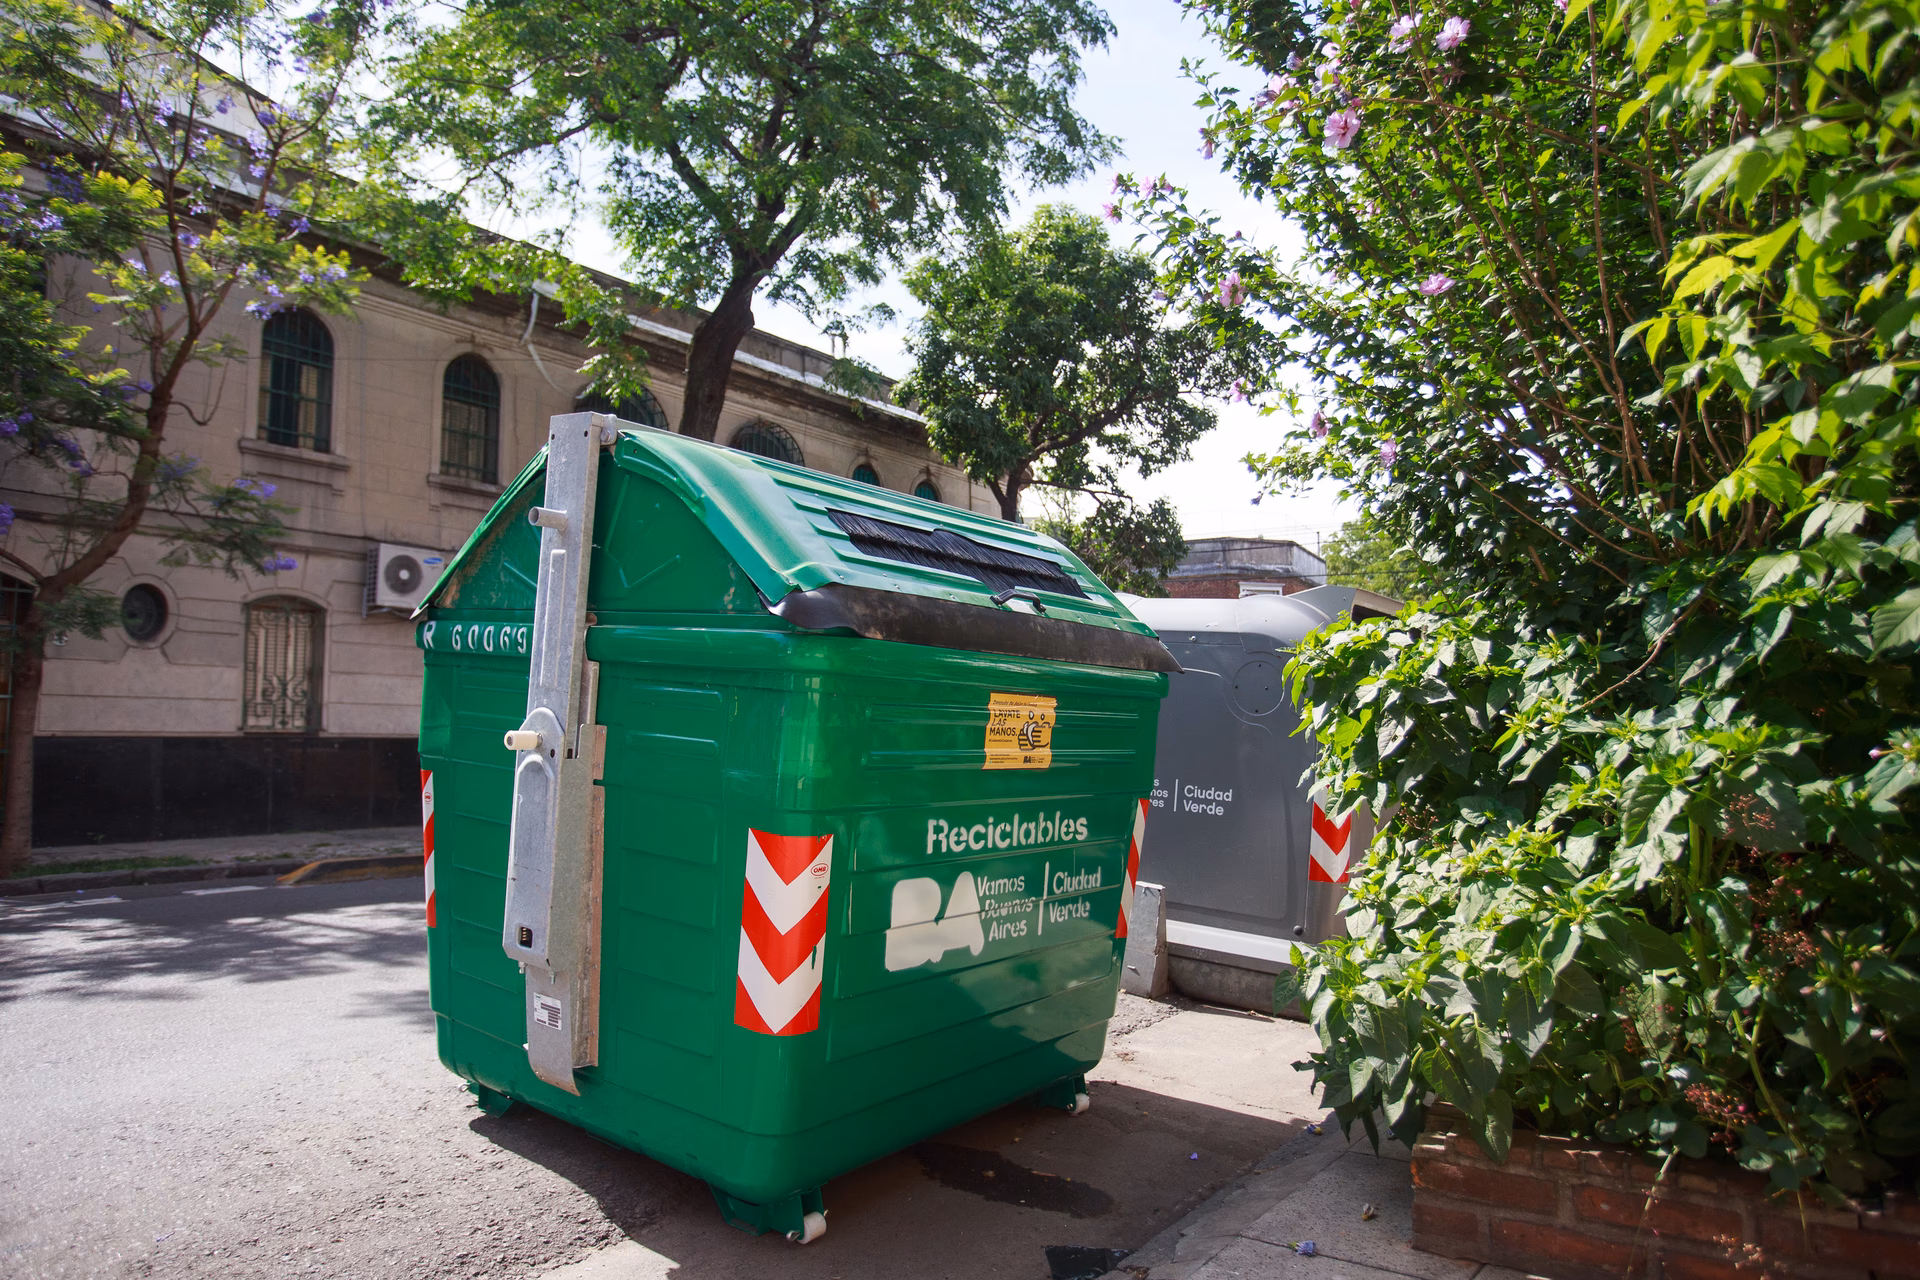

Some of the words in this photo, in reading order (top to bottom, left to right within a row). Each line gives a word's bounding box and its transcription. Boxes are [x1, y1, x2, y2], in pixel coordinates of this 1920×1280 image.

[422, 621, 436, 649] R
[991, 718, 1007, 727] LAS
[993, 709, 1020, 718] LAVATE
[990, 727, 1017, 736] MANOS.
[1149, 789, 1169, 798] nos
[1184, 785, 1232, 802] Ciudad
[1183, 799, 1224, 816] Verde
[926, 811, 1088, 854] Reciclables
[977, 875, 1025, 897] Vamos
[1053, 866, 1101, 894] Ciudad
[981, 897, 1037, 920] Buenos
[1049, 896, 1091, 923] Verde
[988, 919, 1027, 942] Aires
